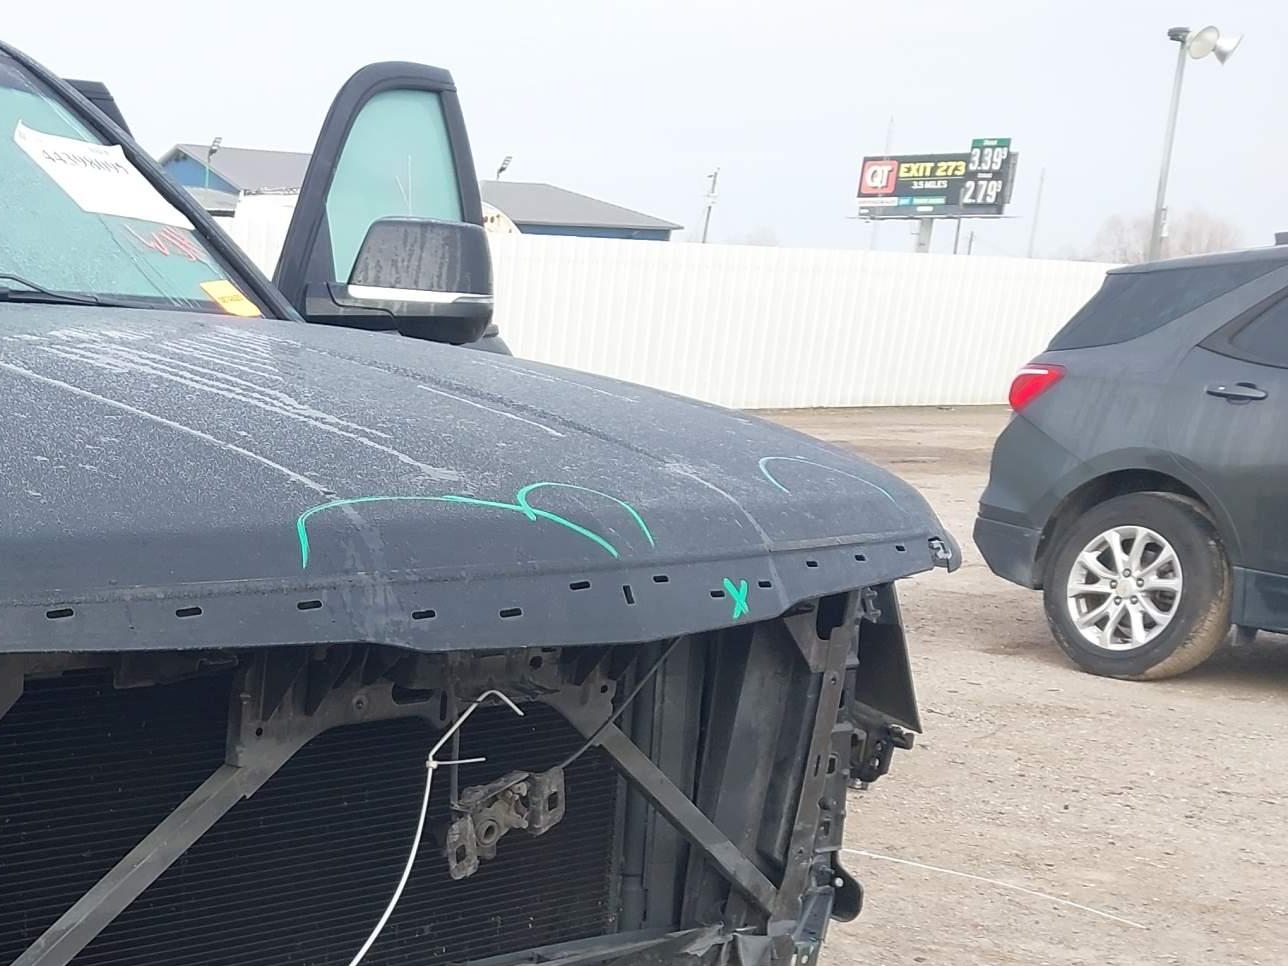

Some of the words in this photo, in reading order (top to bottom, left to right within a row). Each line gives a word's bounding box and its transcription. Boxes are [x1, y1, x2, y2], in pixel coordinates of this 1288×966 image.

[864, 165, 893, 189] QT
[897, 163, 934, 178] EXIT
[935, 160, 967, 176] 273
